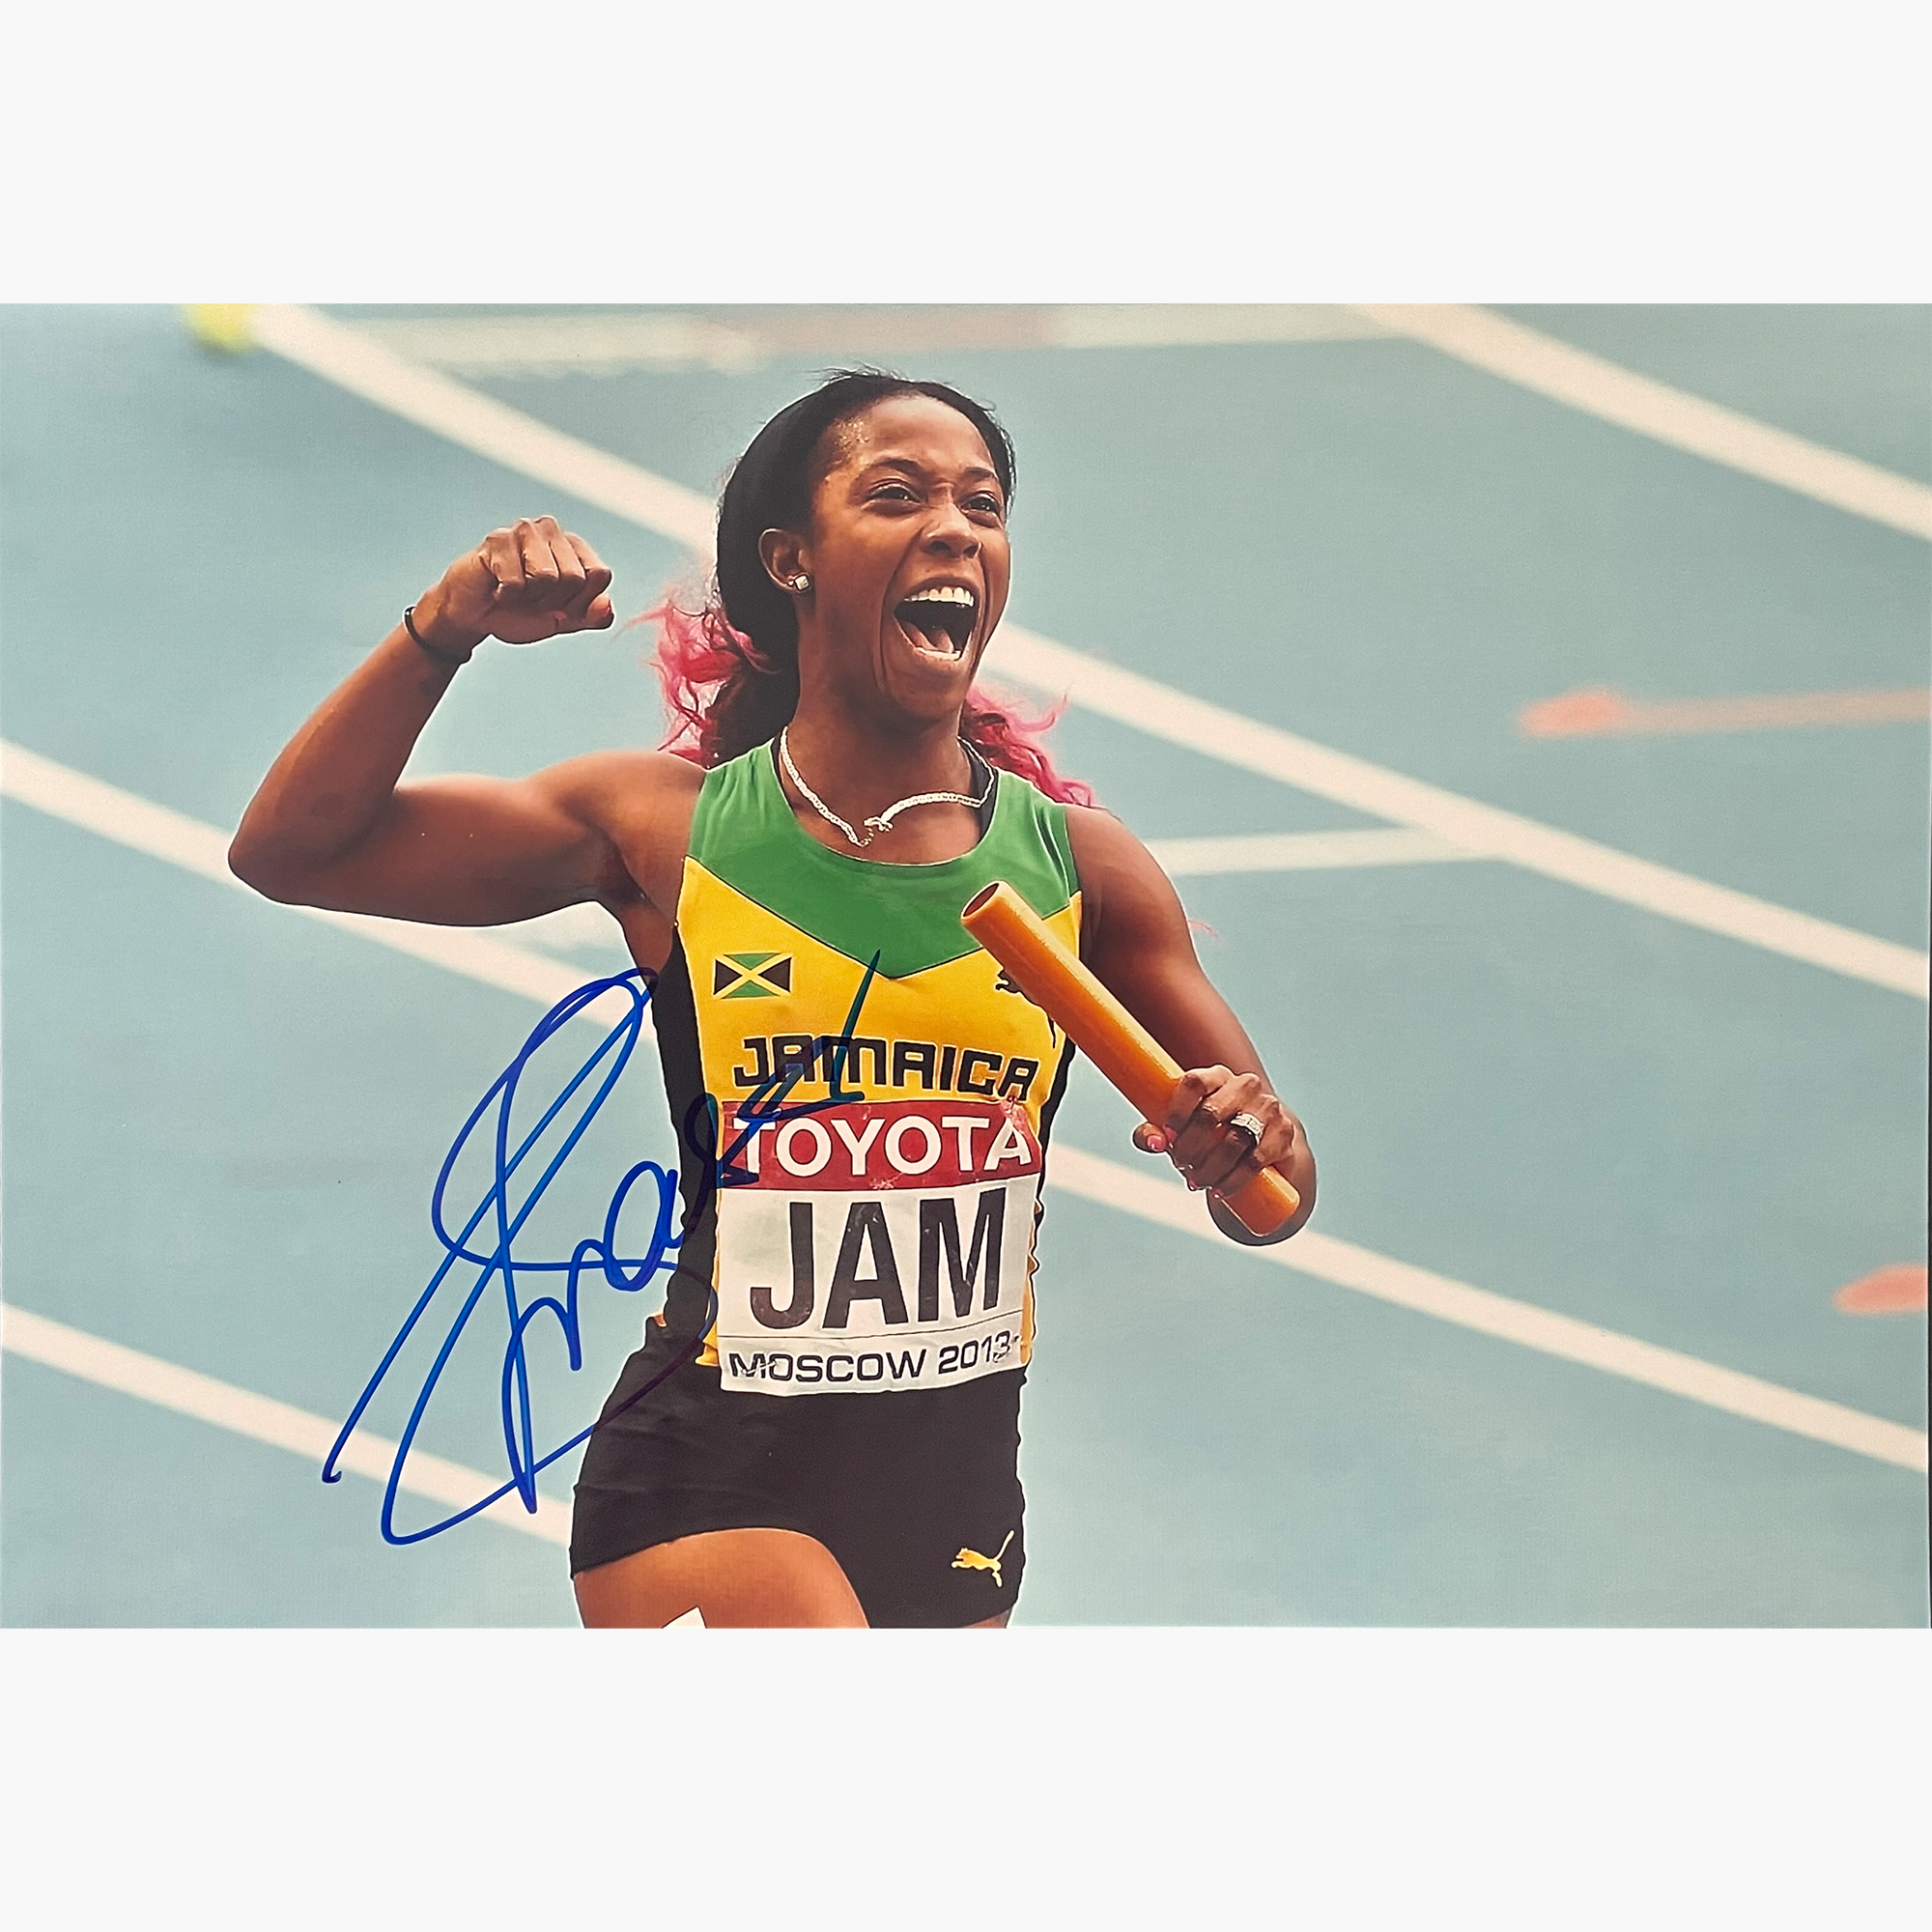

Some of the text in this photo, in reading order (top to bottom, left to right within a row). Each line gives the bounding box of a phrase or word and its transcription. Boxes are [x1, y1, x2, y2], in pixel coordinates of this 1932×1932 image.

[736, 1036, 1039, 1099] JAMAICA
[733, 1116, 1032, 1177] TOYOTA
[750, 1187, 1007, 1329] JAM
[729, 1331, 1010, 1382] MOSCOW 2013
